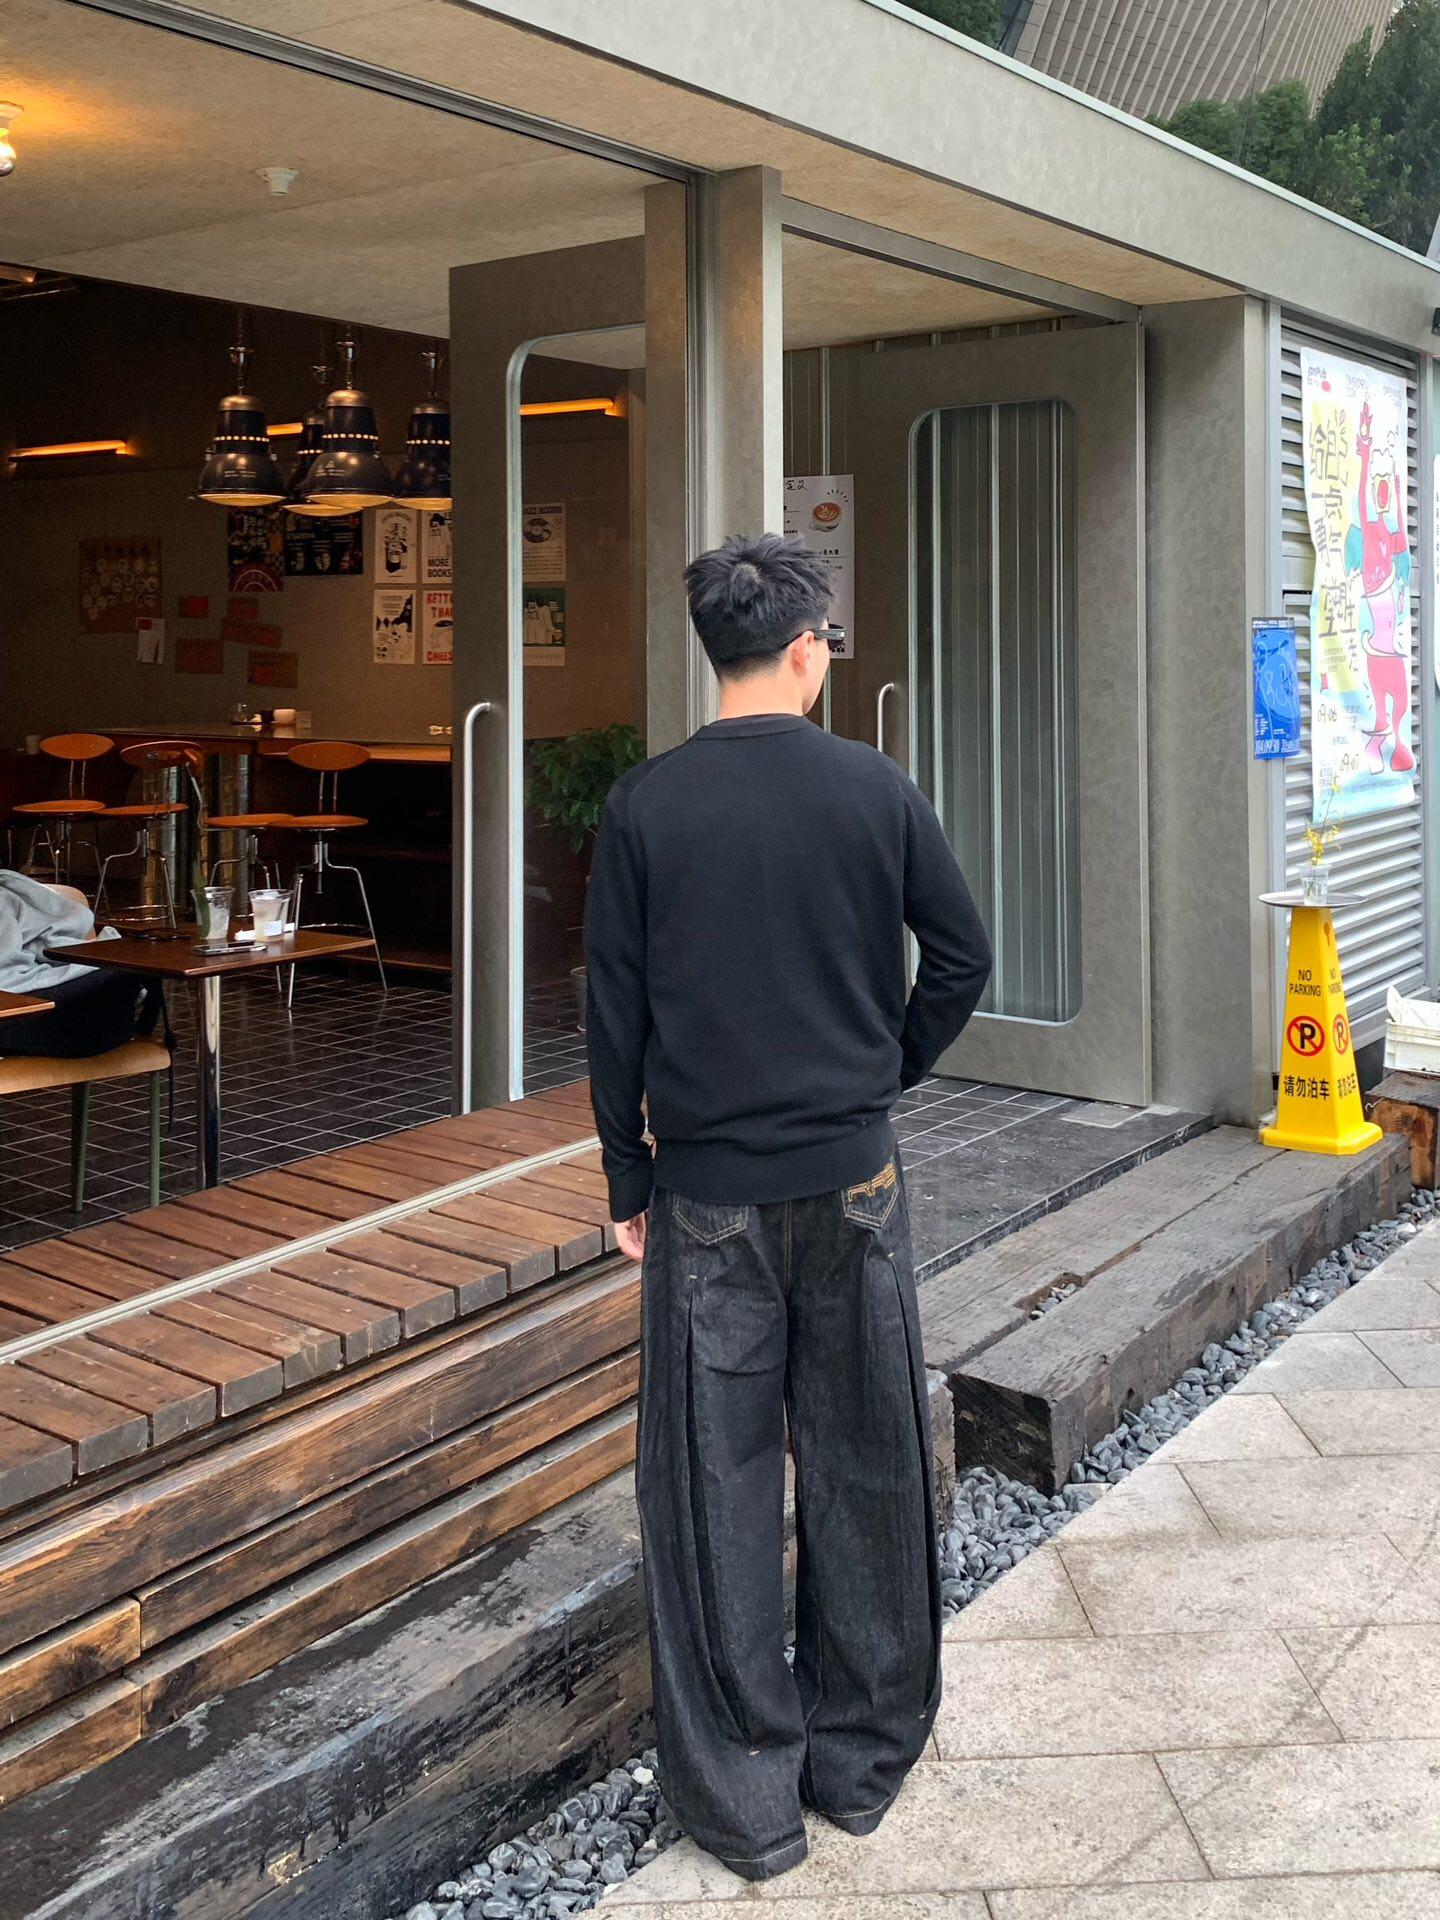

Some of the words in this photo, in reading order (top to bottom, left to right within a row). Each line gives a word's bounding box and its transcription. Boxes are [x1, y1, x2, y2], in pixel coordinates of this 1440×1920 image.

[428, 559, 449, 567] MORE
[427, 568, 452, 577] BOOKS
[1298, 969, 1312, 981] NO
[1289, 983, 1321, 997] PARKING
[1284, 1075, 1330, 1100] 请勿泊车
